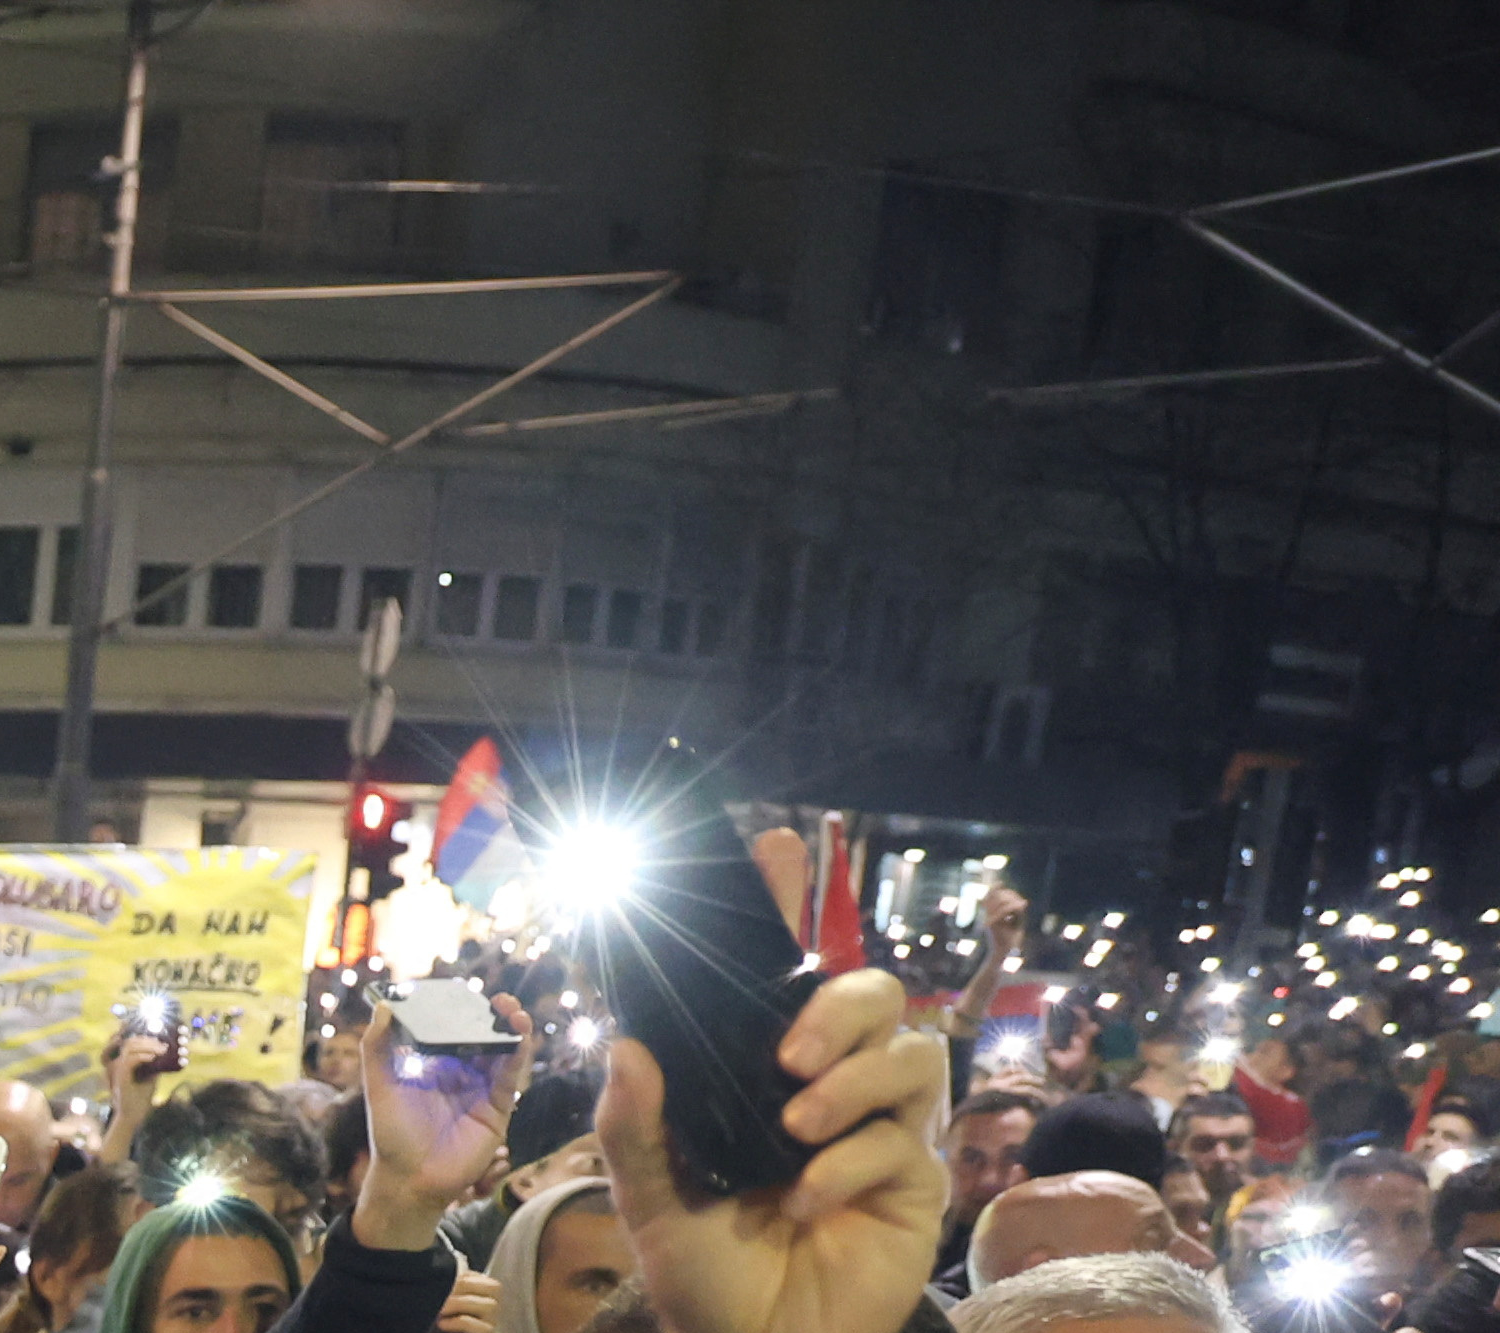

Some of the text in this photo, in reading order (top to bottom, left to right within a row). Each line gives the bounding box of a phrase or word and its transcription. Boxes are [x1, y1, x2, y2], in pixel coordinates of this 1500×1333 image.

[129, 908, 271, 937] DA NAM
[132, 952, 262, 987] KONAČNO
